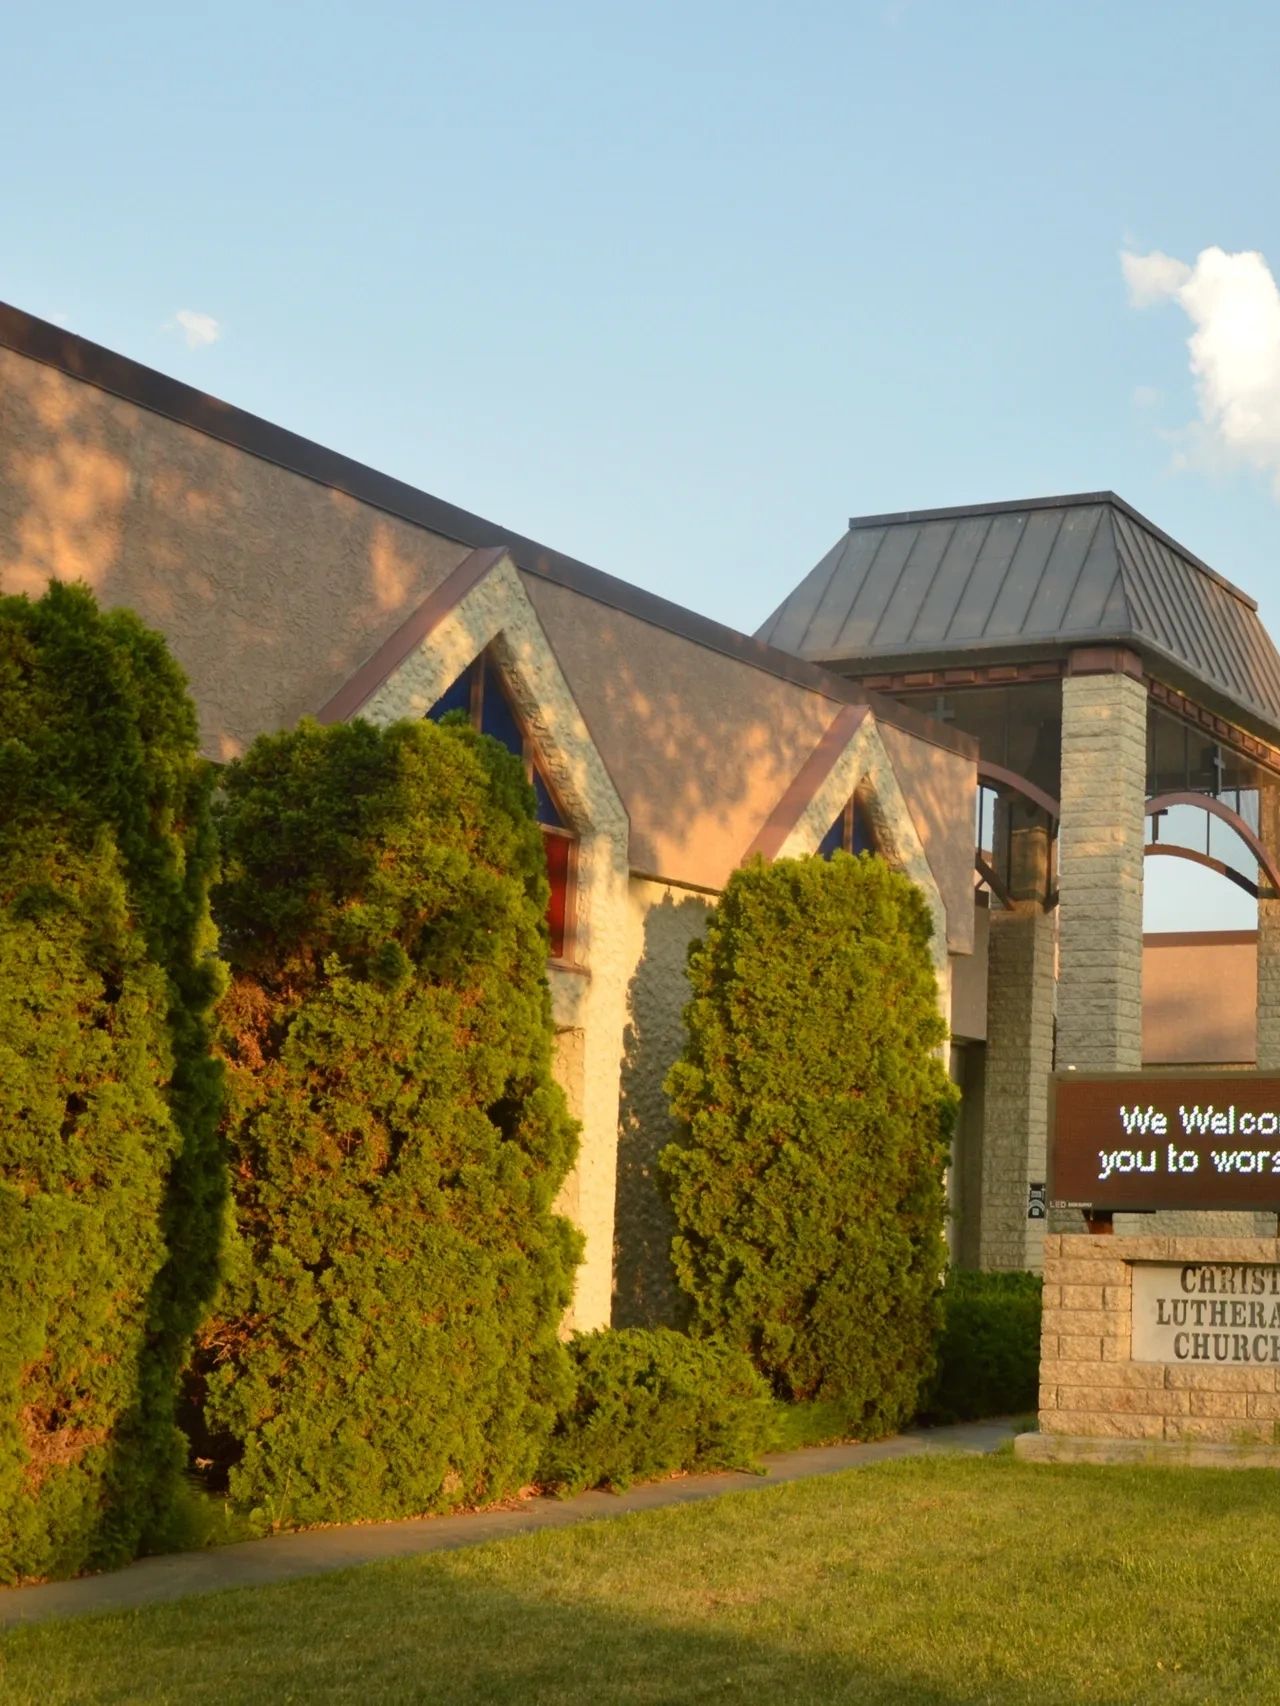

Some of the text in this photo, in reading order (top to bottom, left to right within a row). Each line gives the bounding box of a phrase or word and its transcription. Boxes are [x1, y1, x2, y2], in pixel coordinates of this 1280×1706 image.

[1120, 1105, 1167, 1135] We
[1098, 1150, 1157, 1180] you
[1168, 1143, 1199, 1173] to
